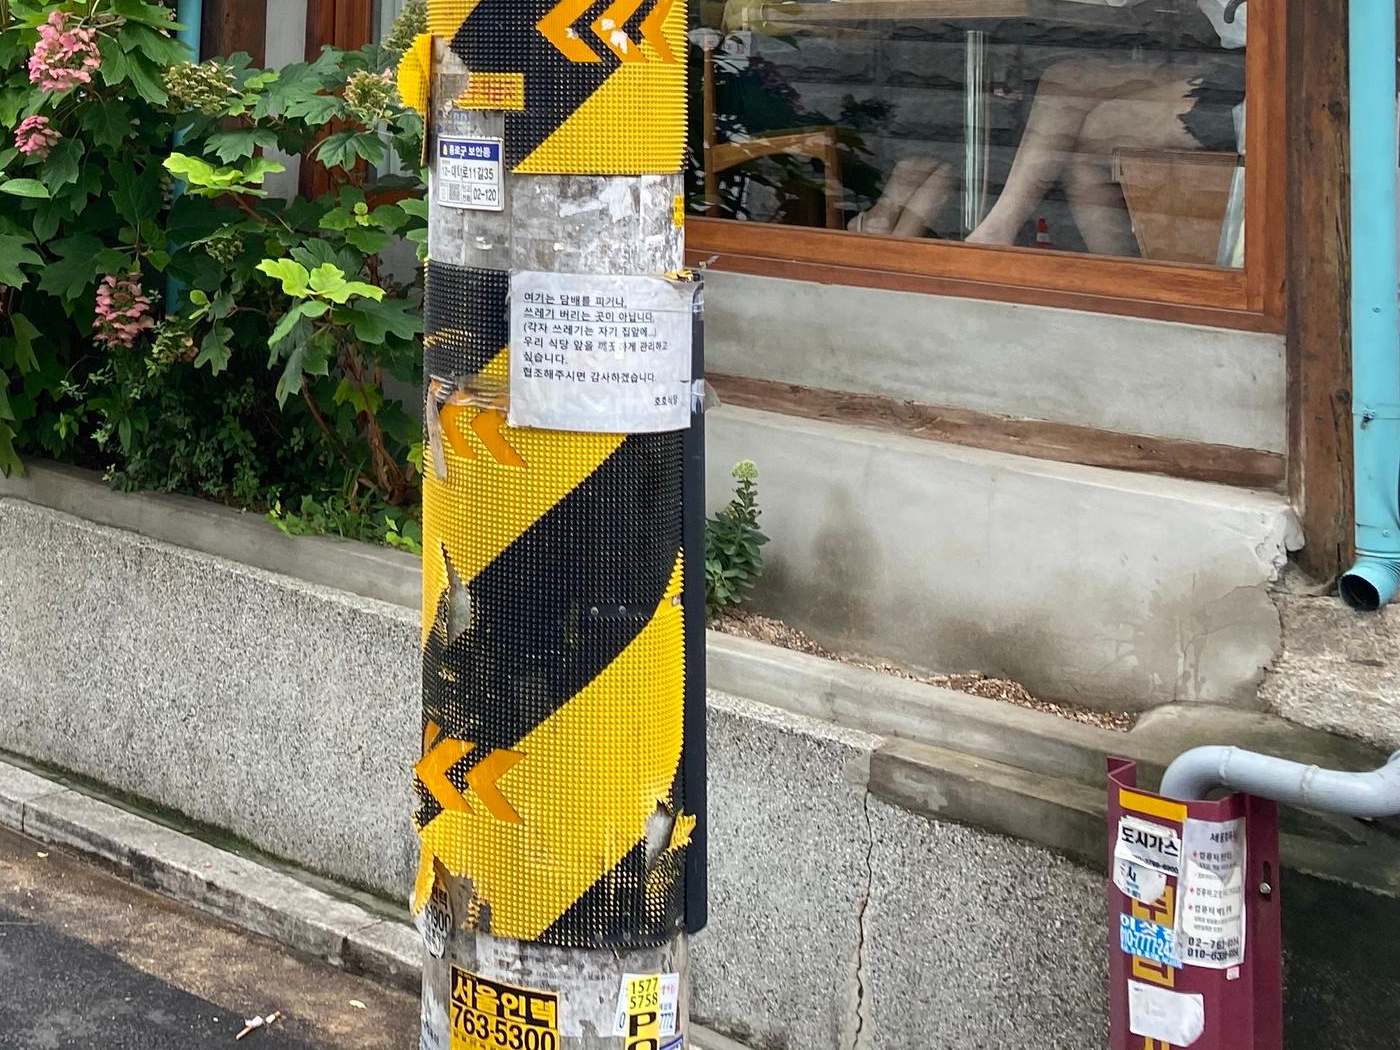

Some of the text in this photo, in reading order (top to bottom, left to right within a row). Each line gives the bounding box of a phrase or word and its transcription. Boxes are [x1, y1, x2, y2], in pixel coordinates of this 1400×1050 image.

[473, 187, 497, 202] 02-120
[524, 292, 555, 305] 여기는
[560, 294, 590, 306] 담배를
[524, 308, 555, 320] 쓰레기
[560, 310, 591, 322] 버리는
[596, 311, 614, 323] 곳이
[524, 323, 547, 334] (각자
[552, 325, 594, 337] 쓰레기는
[599, 326, 617, 338] 자기
[524, 337, 543, 348] 우리
[549, 339, 569, 350] 식당
[574, 341, 593, 351] 앞을
[523, 367, 586, 382] 협조해주시면
[1121, 826, 1179, 857] 도시가스
[631, 977, 658, 995] 1577
[453, 976, 556, 1028] 서울인력
[629, 992, 658, 1009] 5758
[452, 1002, 556, 1050] 763-5300
